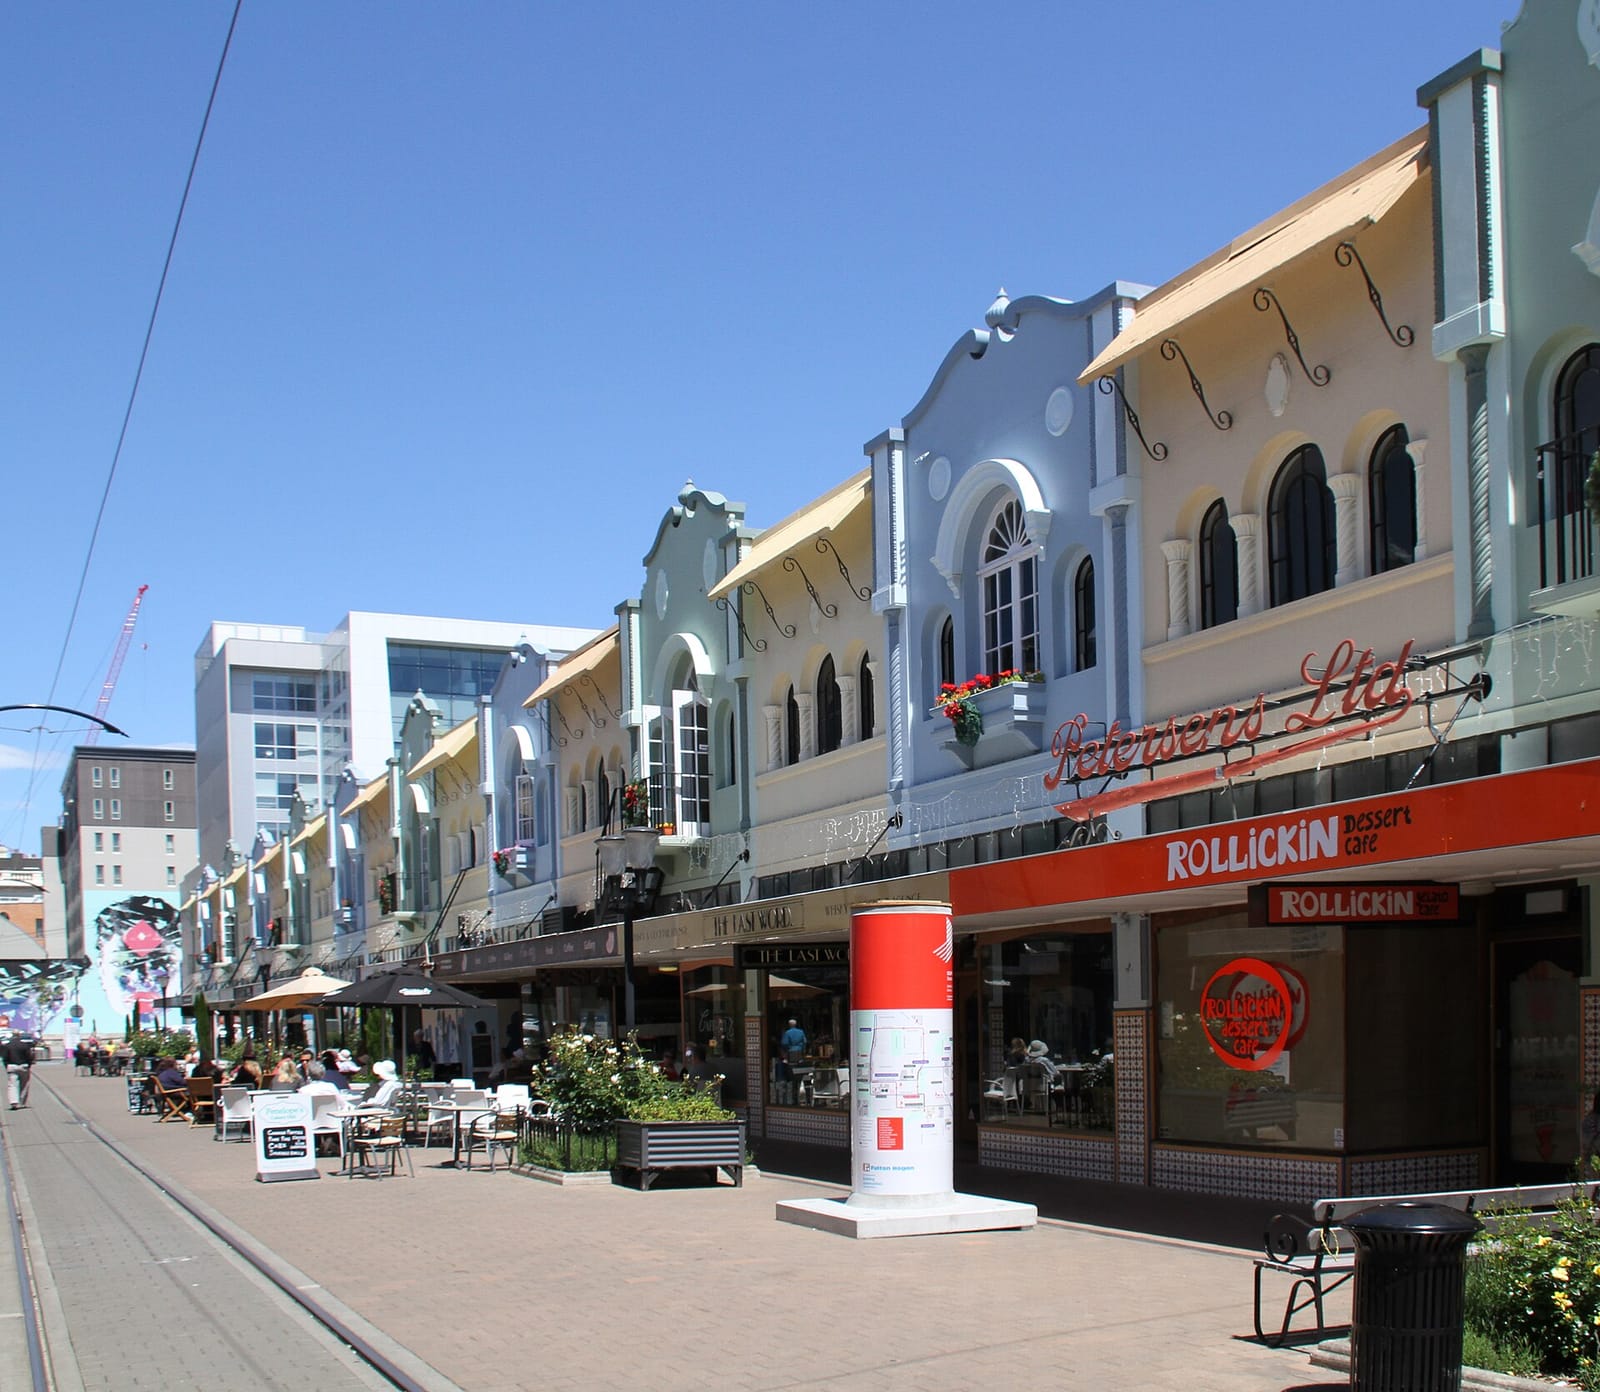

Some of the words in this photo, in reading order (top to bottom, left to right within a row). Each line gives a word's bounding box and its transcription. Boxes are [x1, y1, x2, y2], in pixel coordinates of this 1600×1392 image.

[1044, 692, 1265, 790] Petersens
[1284, 638, 1414, 733] Ltd
[714, 916, 728, 937] THE
[733, 911, 755, 934] LAST
[760, 949, 783, 963] THE
[789, 948, 819, 962] LAST
